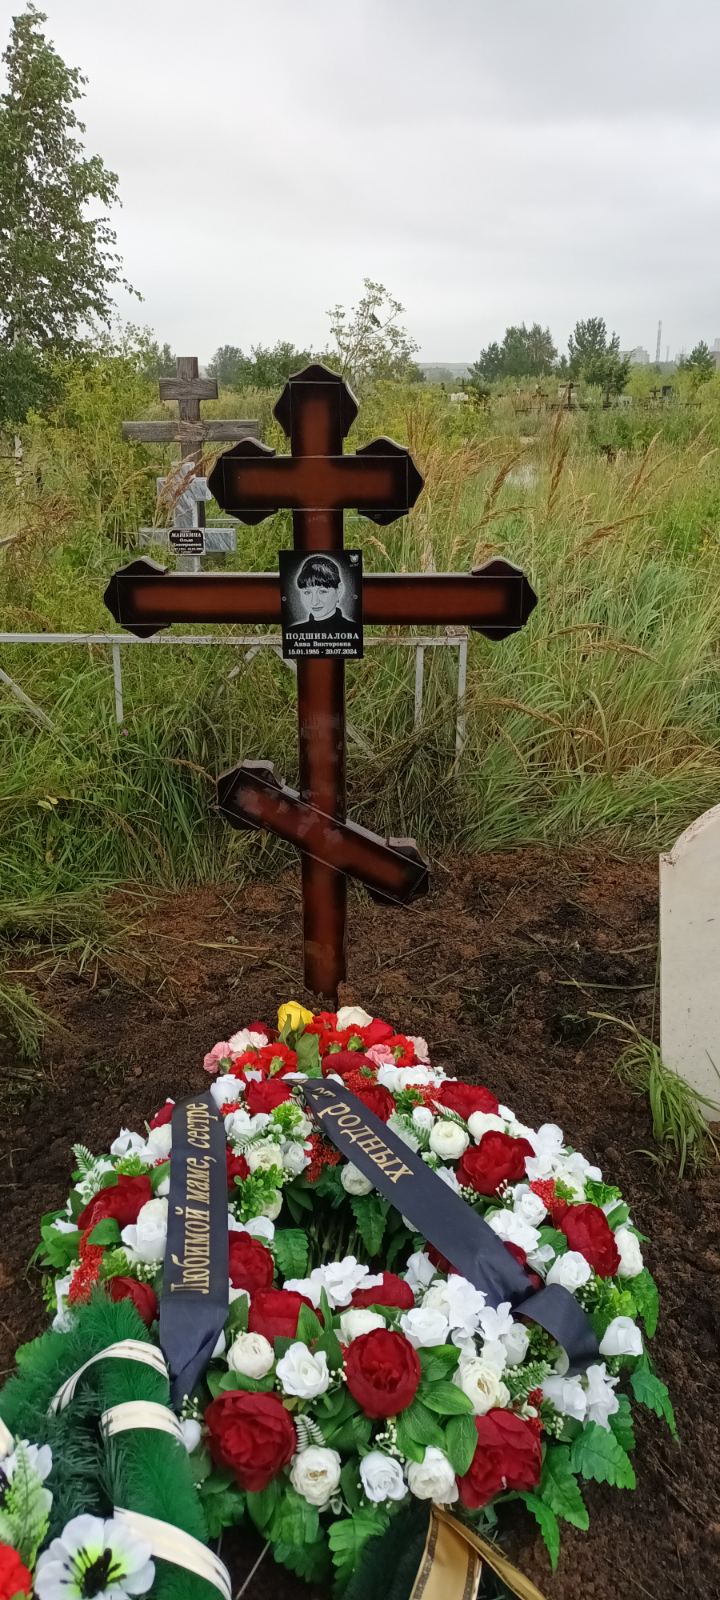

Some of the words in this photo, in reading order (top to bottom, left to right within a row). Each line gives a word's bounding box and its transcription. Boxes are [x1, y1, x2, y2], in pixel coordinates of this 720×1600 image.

[285, 632, 359, 641] ПОДШИВАЛОВА
[186, 1102, 219, 1150] сестре
[317, 1101, 415, 1184] родных
[186, 1155, 217, 1205] маме,
[170, 1206, 210, 1295] Любимой
